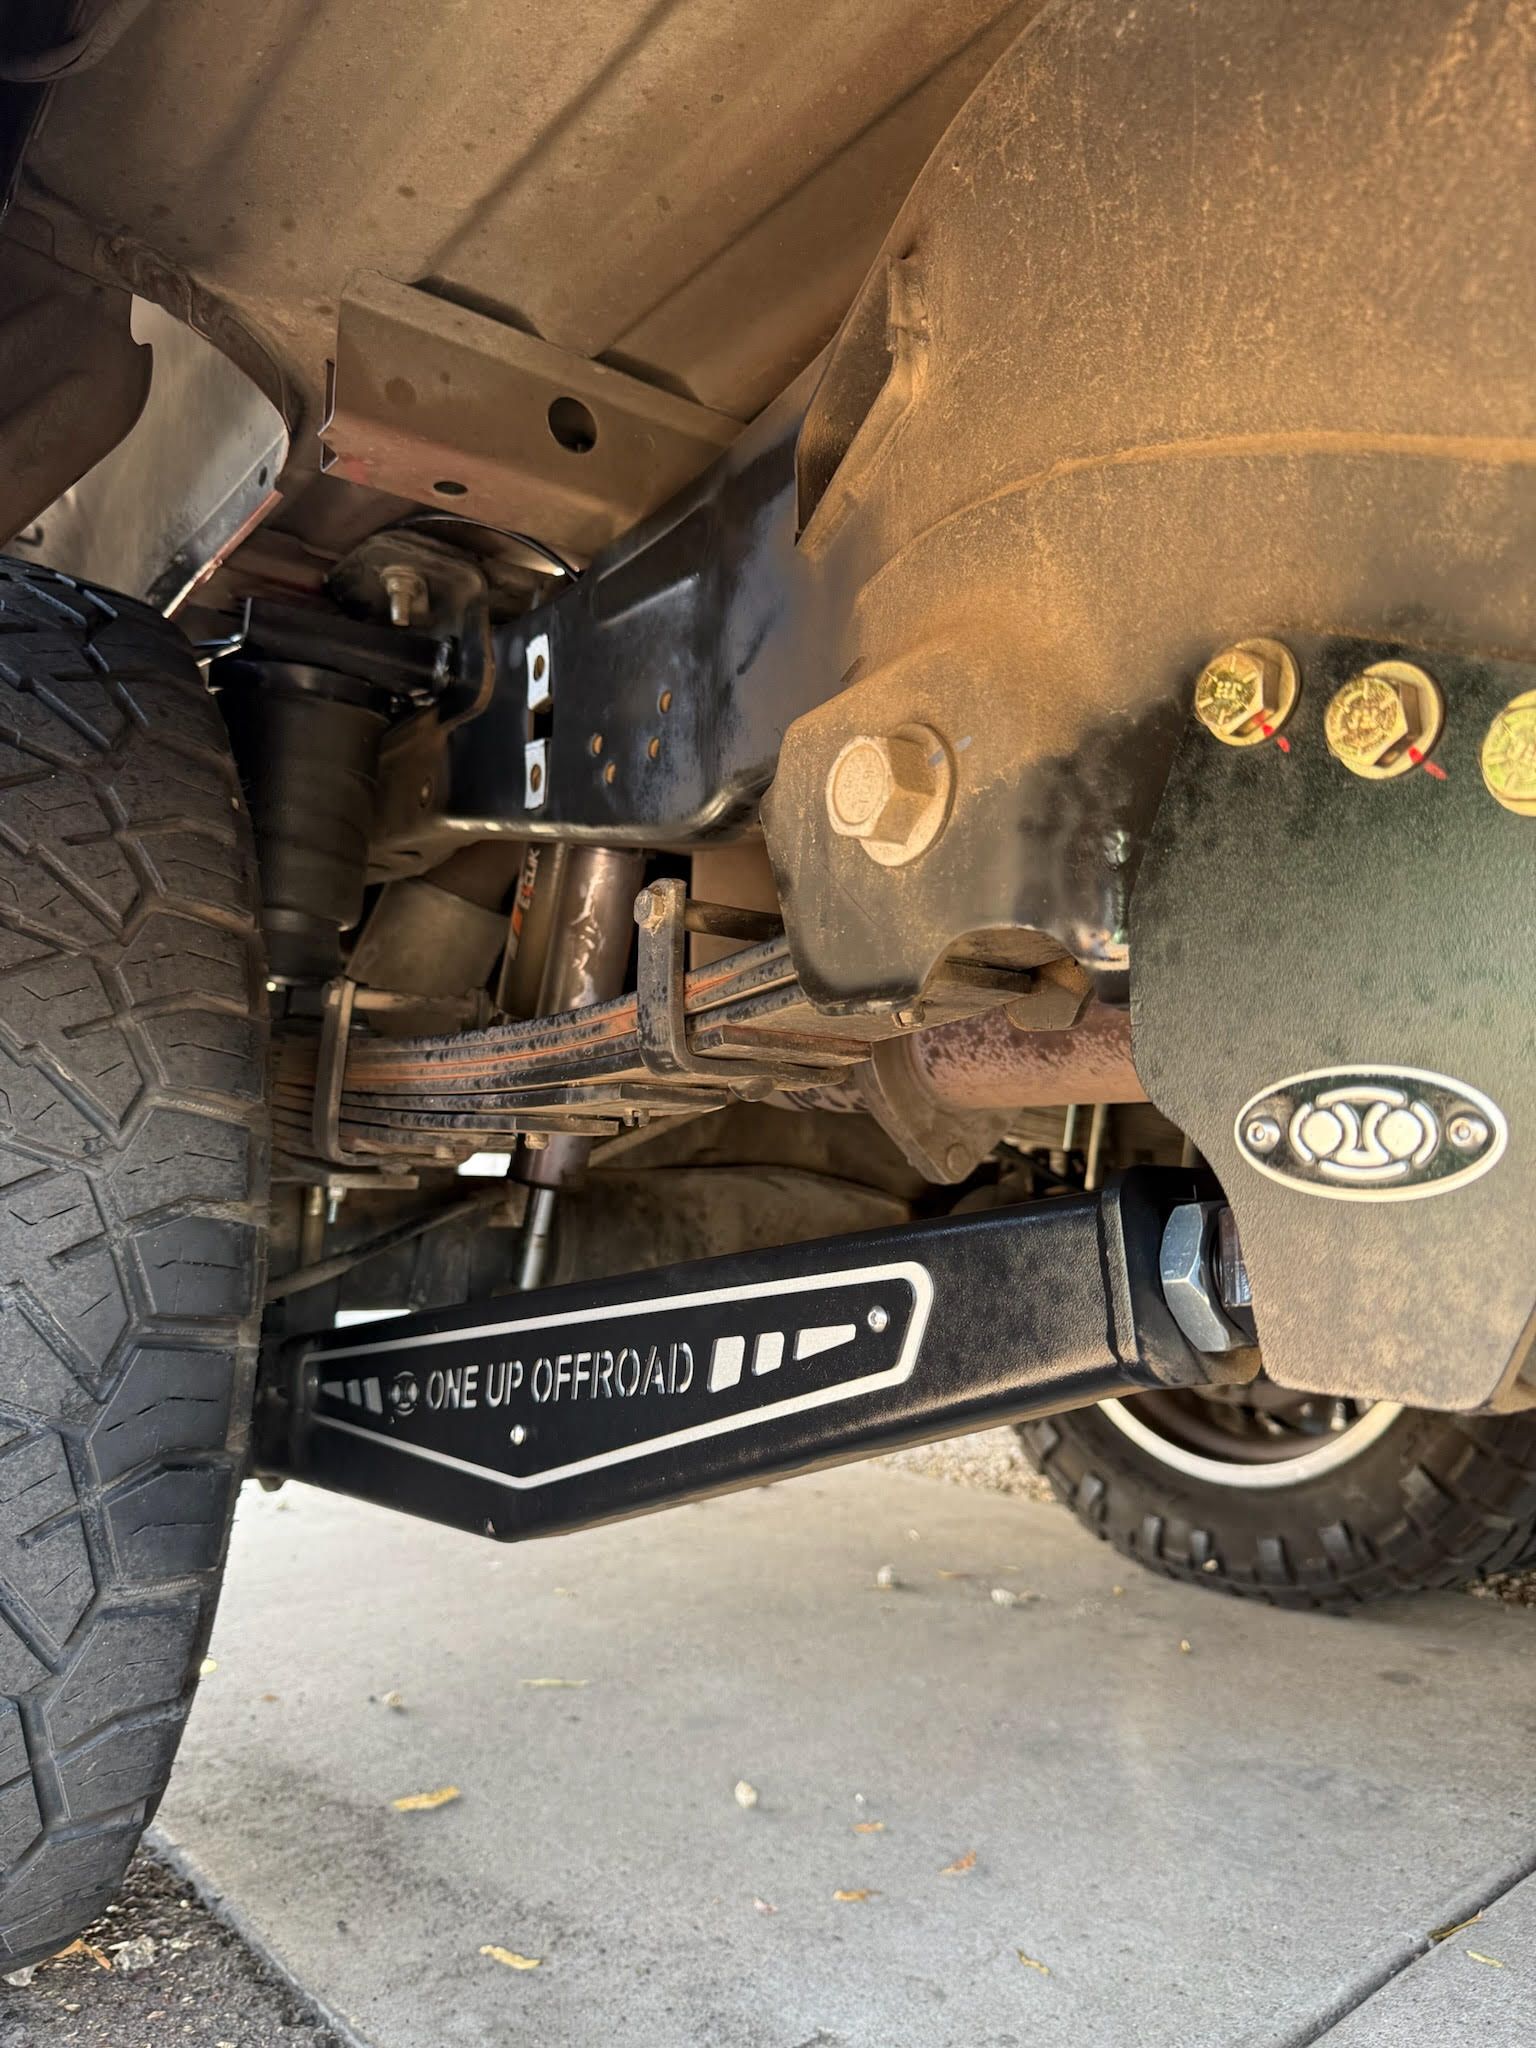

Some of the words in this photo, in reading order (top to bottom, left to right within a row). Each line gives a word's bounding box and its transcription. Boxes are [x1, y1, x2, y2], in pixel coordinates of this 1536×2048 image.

[427, 1365, 479, 1409] ONE
[486, 1360, 523, 1407] UP
[531, 1342, 694, 1402] OFFROAD
